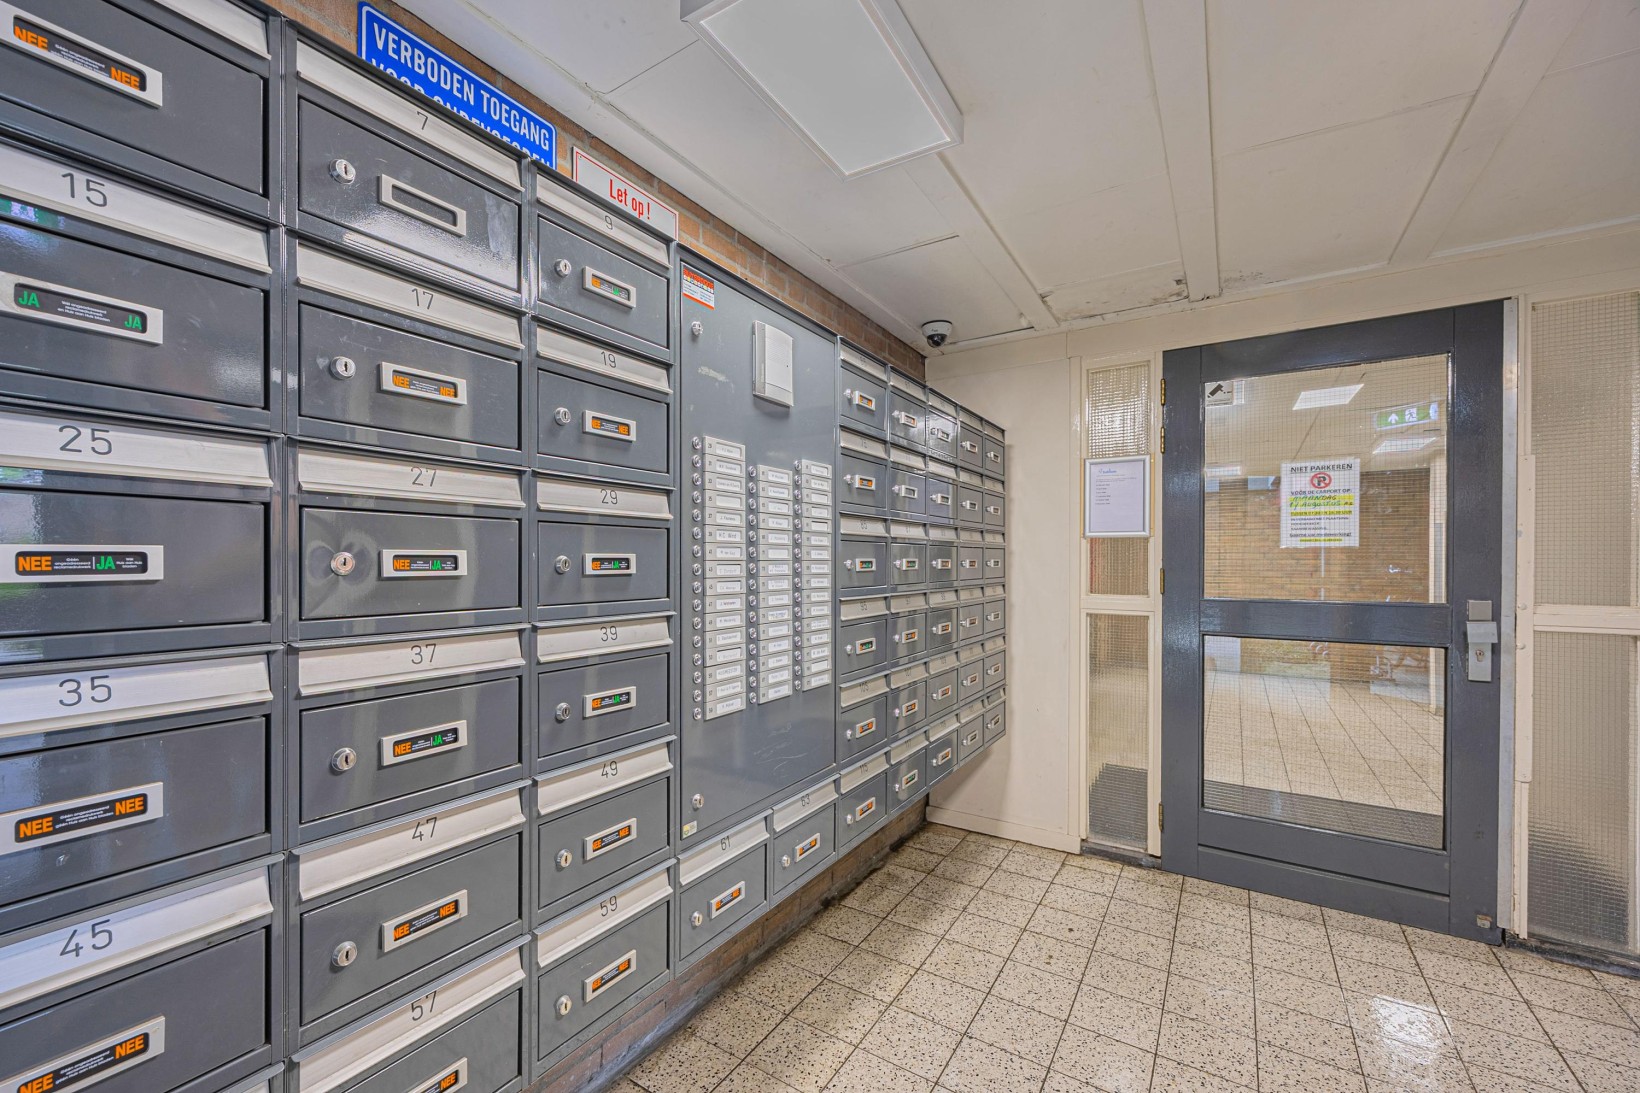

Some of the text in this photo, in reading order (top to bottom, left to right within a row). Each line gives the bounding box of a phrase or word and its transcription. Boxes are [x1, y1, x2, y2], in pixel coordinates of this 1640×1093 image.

[14, 25, 48, 51] NEE
[111, 66, 140, 91] NEE
[373, 22, 474, 105] VERBODEN
[480, 90, 550, 151] TOEGANG
[416, 111, 429, 130] 7
[61, 172, 107, 207] 15
[609, 178, 628, 207] Let
[631, 197, 644, 219] op
[604, 215, 613, 230] 9
[18, 291, 40, 308] JA
[412, 288, 434, 310] 17
[124, 315, 142, 330] JA
[600, 350, 617, 368] 19
[393, 375, 410, 389] NEE
[440, 386, 456, 398] NEE
[59, 425, 112, 455] 25
[1310, 463, 1353, 472] PARKEREN
[411, 467, 437, 487] 27
[600, 488, 618, 505] 29
[18, 556, 52, 572] NEE
[96, 556, 116, 569] JA
[393, 559, 411, 570] NEE
[432, 559, 442, 570] JA
[600, 625, 618, 642] 39
[410, 643, 437, 665] 37
[59, 675, 112, 706] 35
[394, 742, 412, 756] NEE
[432, 735, 443, 746] JA
[601, 760, 618, 778] 49
[115, 797, 144, 816] NEE
[801, 793, 811, 807] 63
[19, 817, 53, 838] NEE
[412, 816, 438, 841] 47
[720, 835, 731, 850] 61
[440, 901, 456, 918] NEE
[600, 895, 618, 917] 59
[60, 919, 113, 957] 45
[394, 923, 410, 939] NEE
[411, 990, 437, 1021] 57
[115, 1034, 145, 1060] NEE
[19, 1073, 54, 1093] NEE
[440, 1072, 456, 1091] NEE
